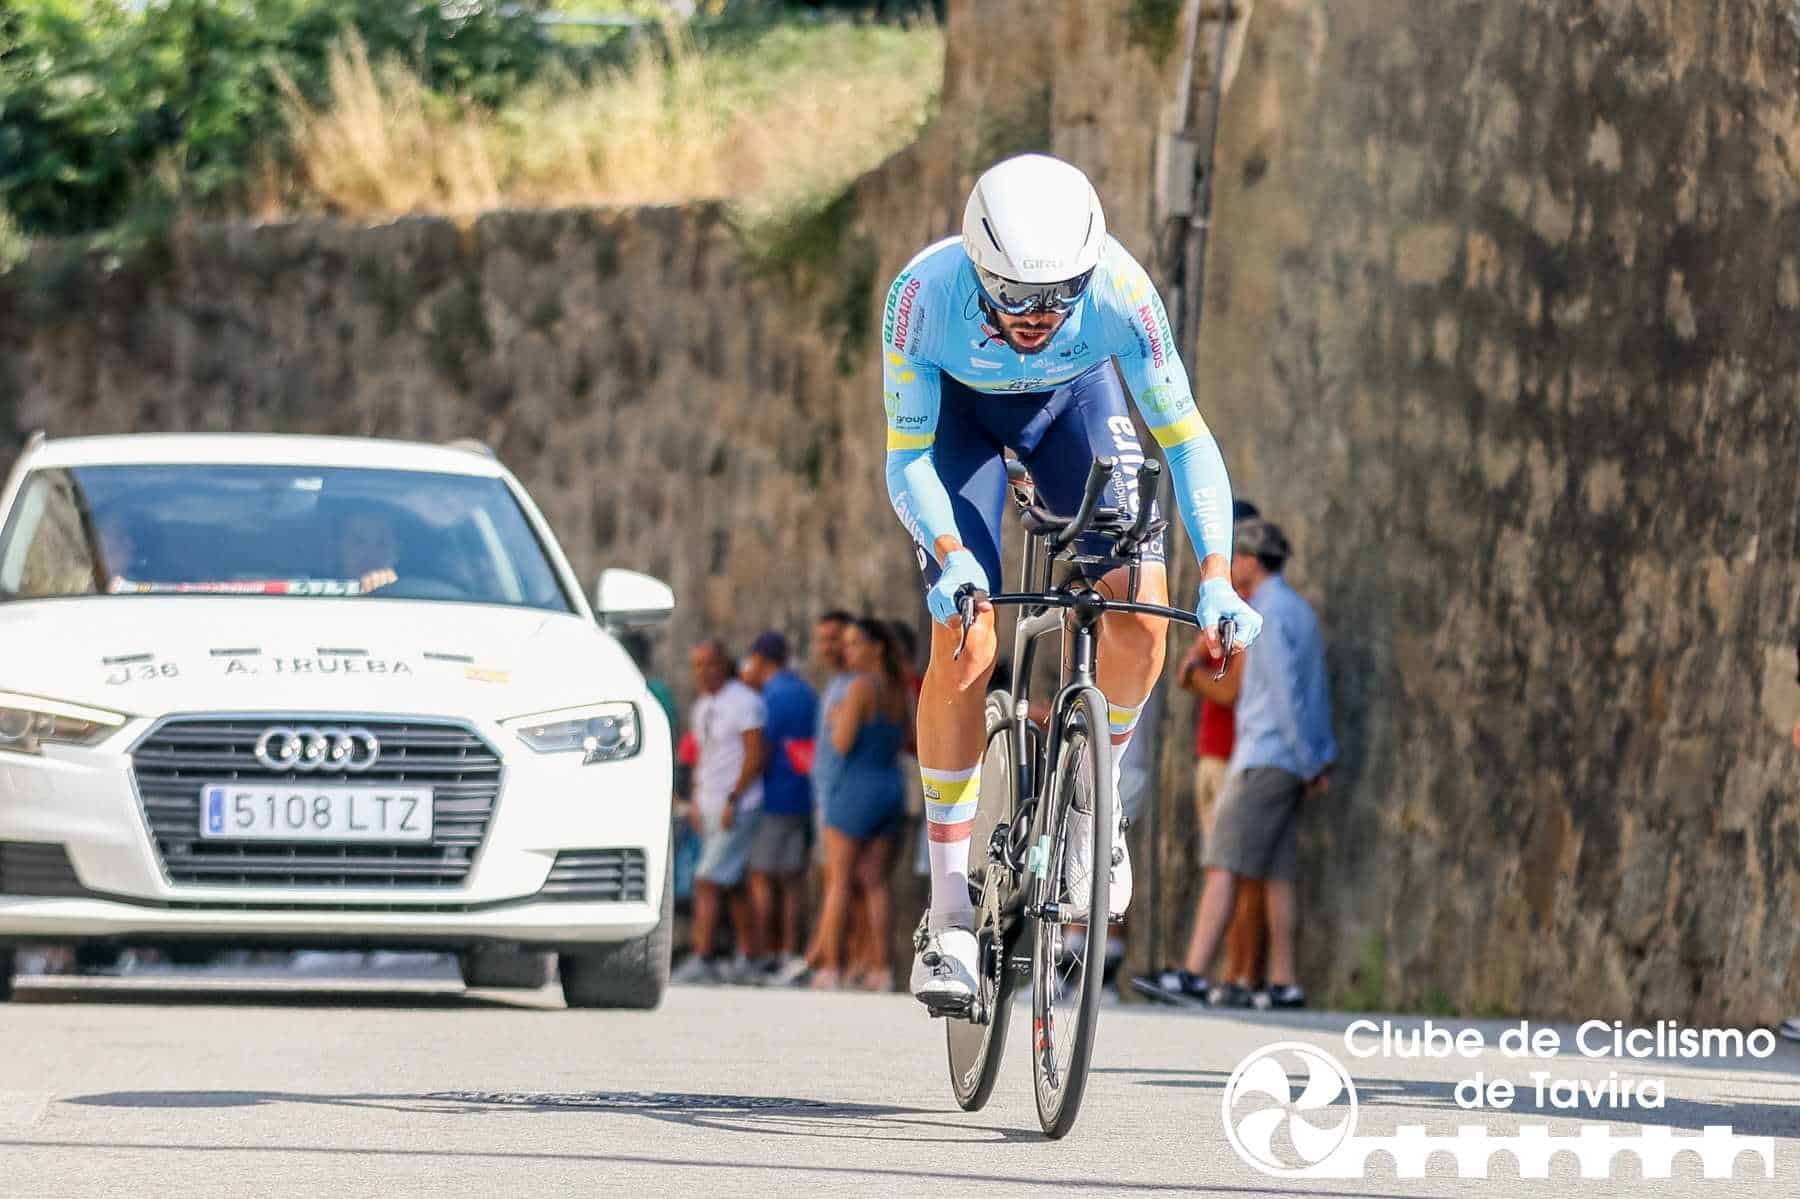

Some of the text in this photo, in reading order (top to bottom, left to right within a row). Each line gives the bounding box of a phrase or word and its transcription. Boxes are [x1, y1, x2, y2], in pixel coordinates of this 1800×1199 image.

[883, 271, 912, 346] GLOBAL
[894, 278, 921, 352] AVOCADOS
[1138, 304, 1164, 369] AVOCADOS
[274, 657, 413, 676] TRUEBA
[235, 793, 420, 831] 5108 LTZ
